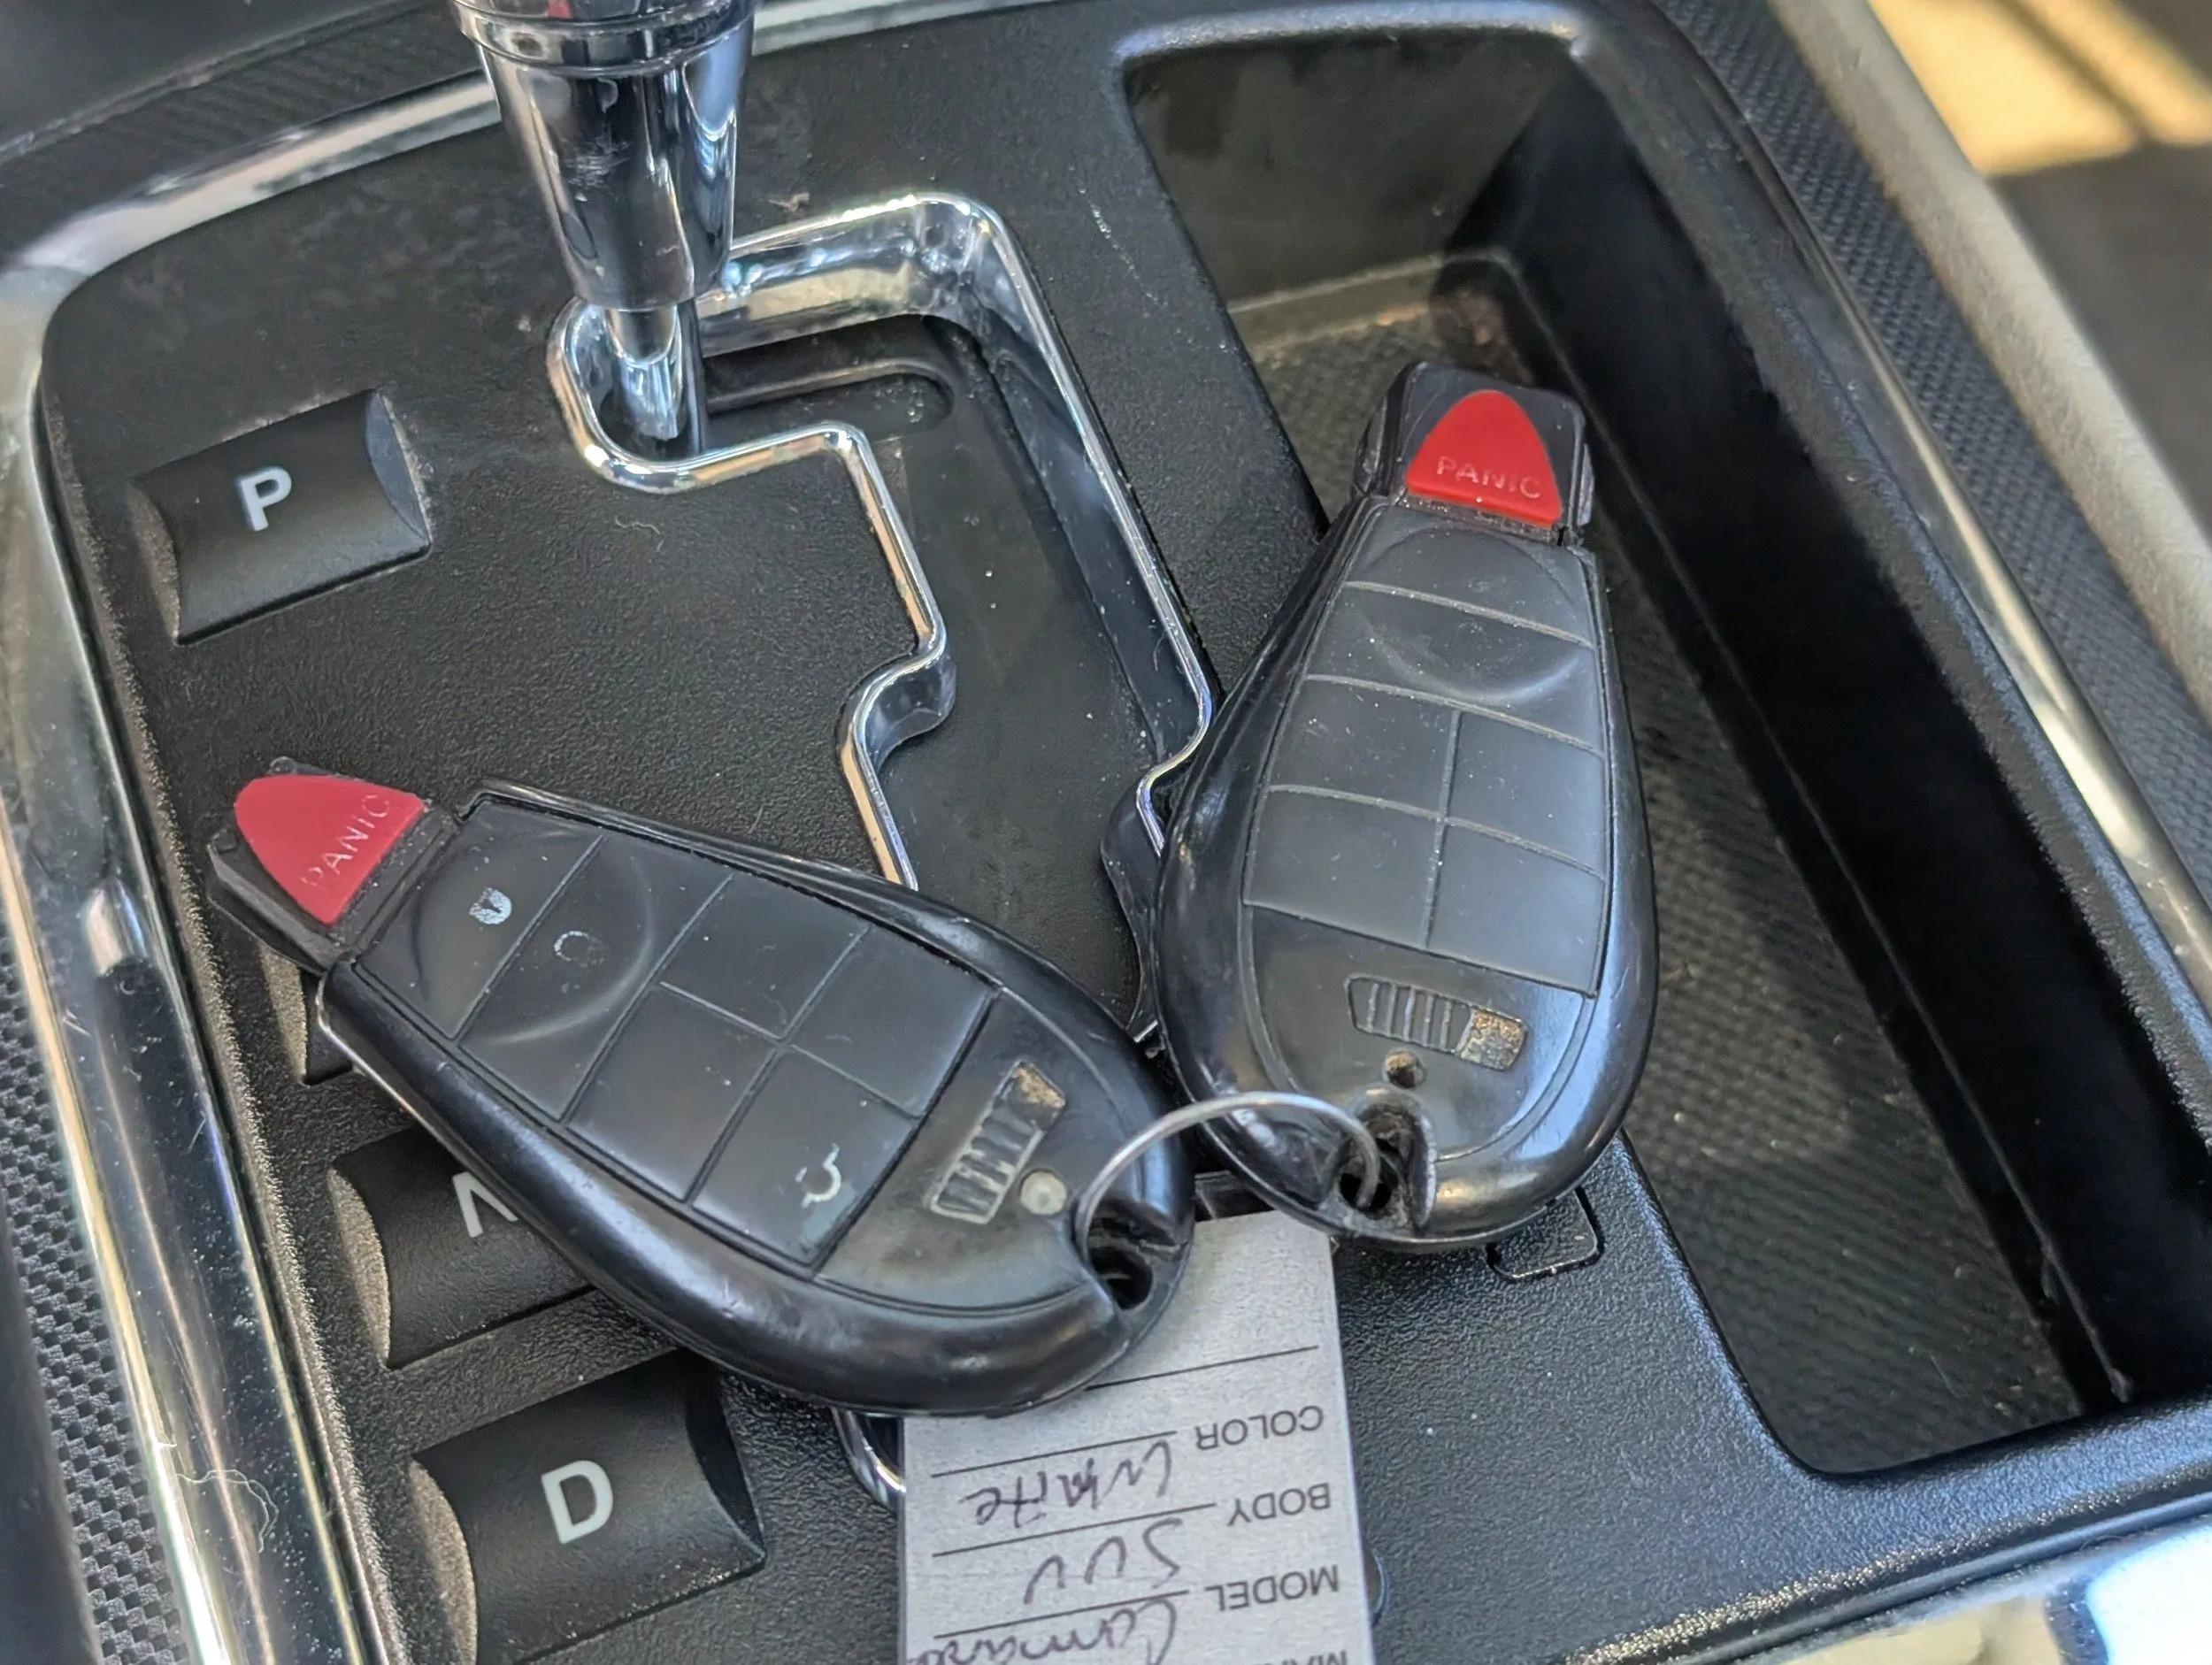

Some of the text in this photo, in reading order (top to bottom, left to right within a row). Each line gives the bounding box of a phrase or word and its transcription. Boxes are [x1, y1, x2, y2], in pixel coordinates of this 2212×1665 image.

[235, 466, 292, 532] P
[1435, 455, 1542, 499] PANIC
[298, 794, 390, 890] PANIC
[1194, 1405, 1325, 1451] COLOR
[541, 1460, 614, 1545] D
[1226, 1482, 1331, 1526] BODY
[1023, 1516, 1184, 1605] SUV
[1204, 1563, 1340, 1612] MODEL
